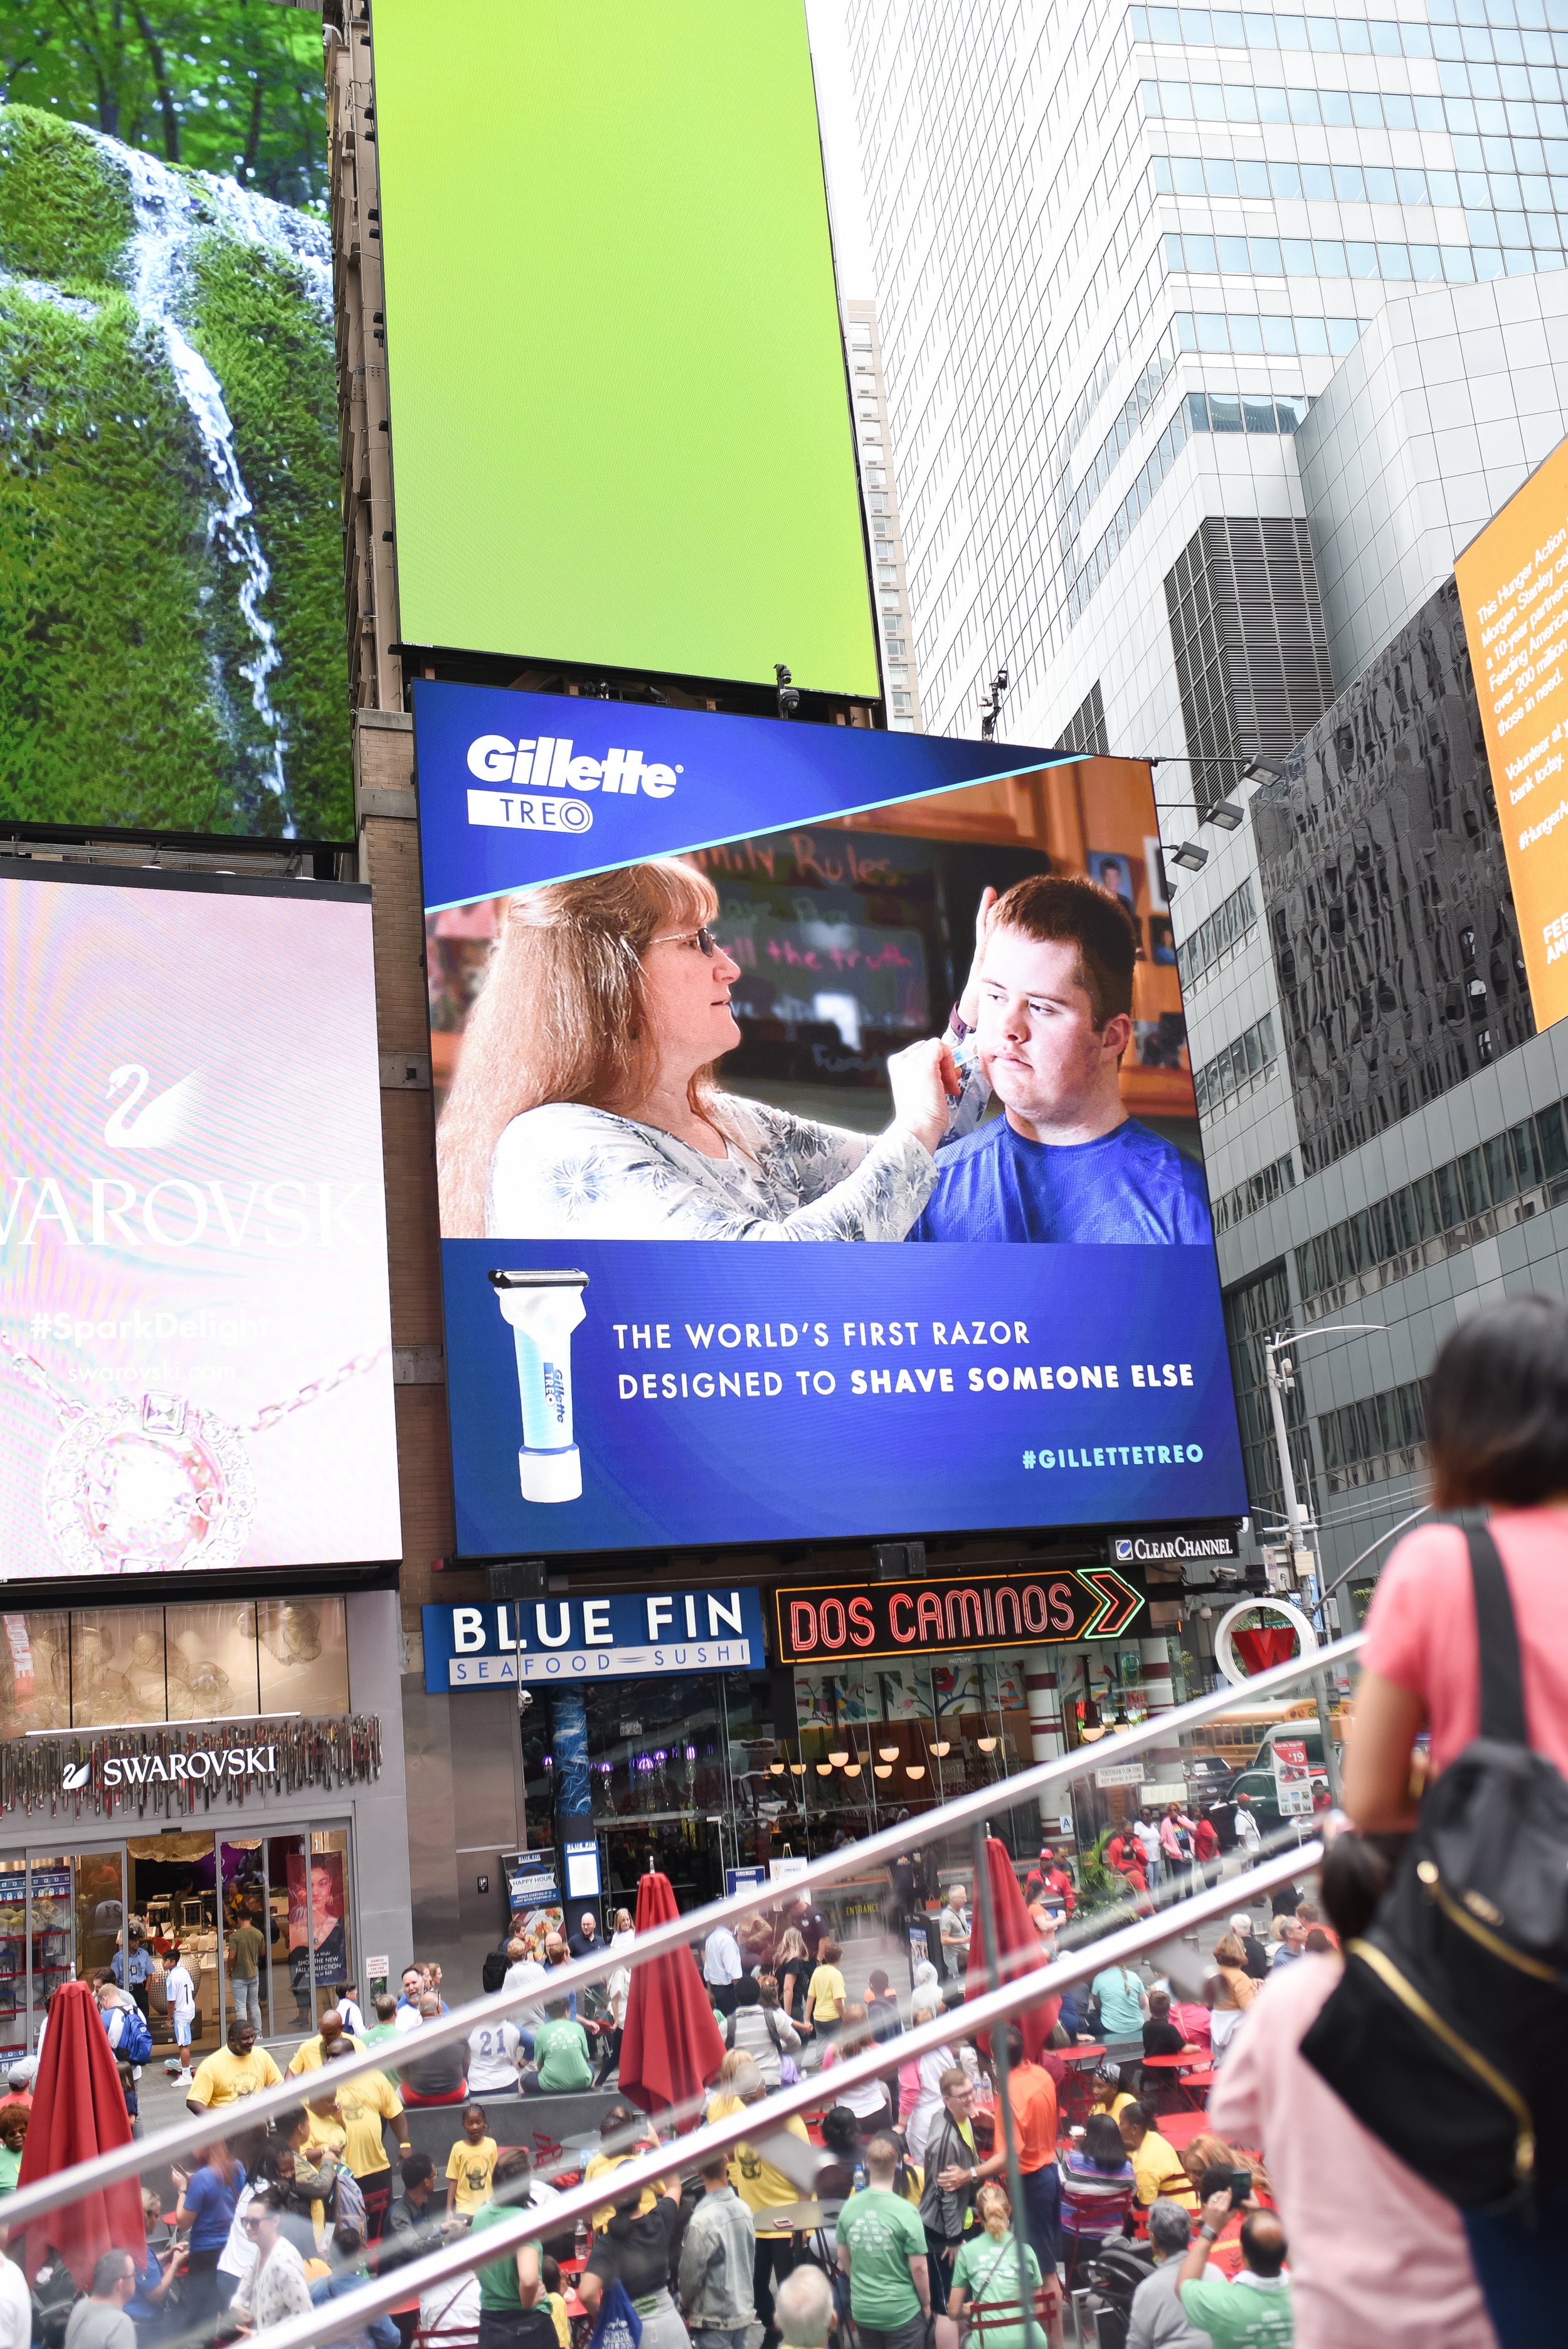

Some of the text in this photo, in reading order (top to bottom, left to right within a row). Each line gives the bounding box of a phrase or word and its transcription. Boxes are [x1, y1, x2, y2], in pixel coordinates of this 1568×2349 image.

[1476, 528, 1567, 625] This Hunger Action
[1481, 606, 1517, 648] Morgan
[1517, 568, 1553, 610] Stanley
[1486, 657, 1493, 670] a
[1494, 620, 1528, 660] 10-year
[1489, 649, 1528, 692] Feeding
[1494, 639, 1567, 714] over 200 million
[1497, 667, 1564, 737] those in need.
[1505, 736, 1549, 781] Volunteer
[1552, 723, 1563, 743] at
[1509, 753, 1565, 805] bank today.
[500, 798, 591, 832] TREO
[1518, 800, 1568, 851] #HungerA
[1542, 911, 1568, 945] FEE
[1546, 932, 1568, 964] AM
[29, 1310, 271, 1347] #SparkDelight
[613, 1320, 1030, 1349] THE WORLD'S FIRST RAZOR
[68, 1359, 236, 1382] swarovski.com
[618, 1363, 1194, 1400] DESIGNED TO SHAVE SOMEONE ELSE
[1022, 1443, 1204, 1470] #GILLETTETREO
[452, 1591, 743, 1653] BLUE FIN
[790, 1583, 1074, 1652] DOS CAMINOS
[456, 1644, 745, 1680] SEAFOOD SUSHI
[103, 1746, 276, 1786] SWAROVSKI
[1288, 1751, 1305, 1763] $19
[1063, 1818, 1071, 1829] A
[567, 1843, 583, 1851] BLUE
[513, 1877, 533, 1886] HAPPY
[845, 1903, 879, 1916] ENTRANCE
[480, 2028, 506, 2057] 21
